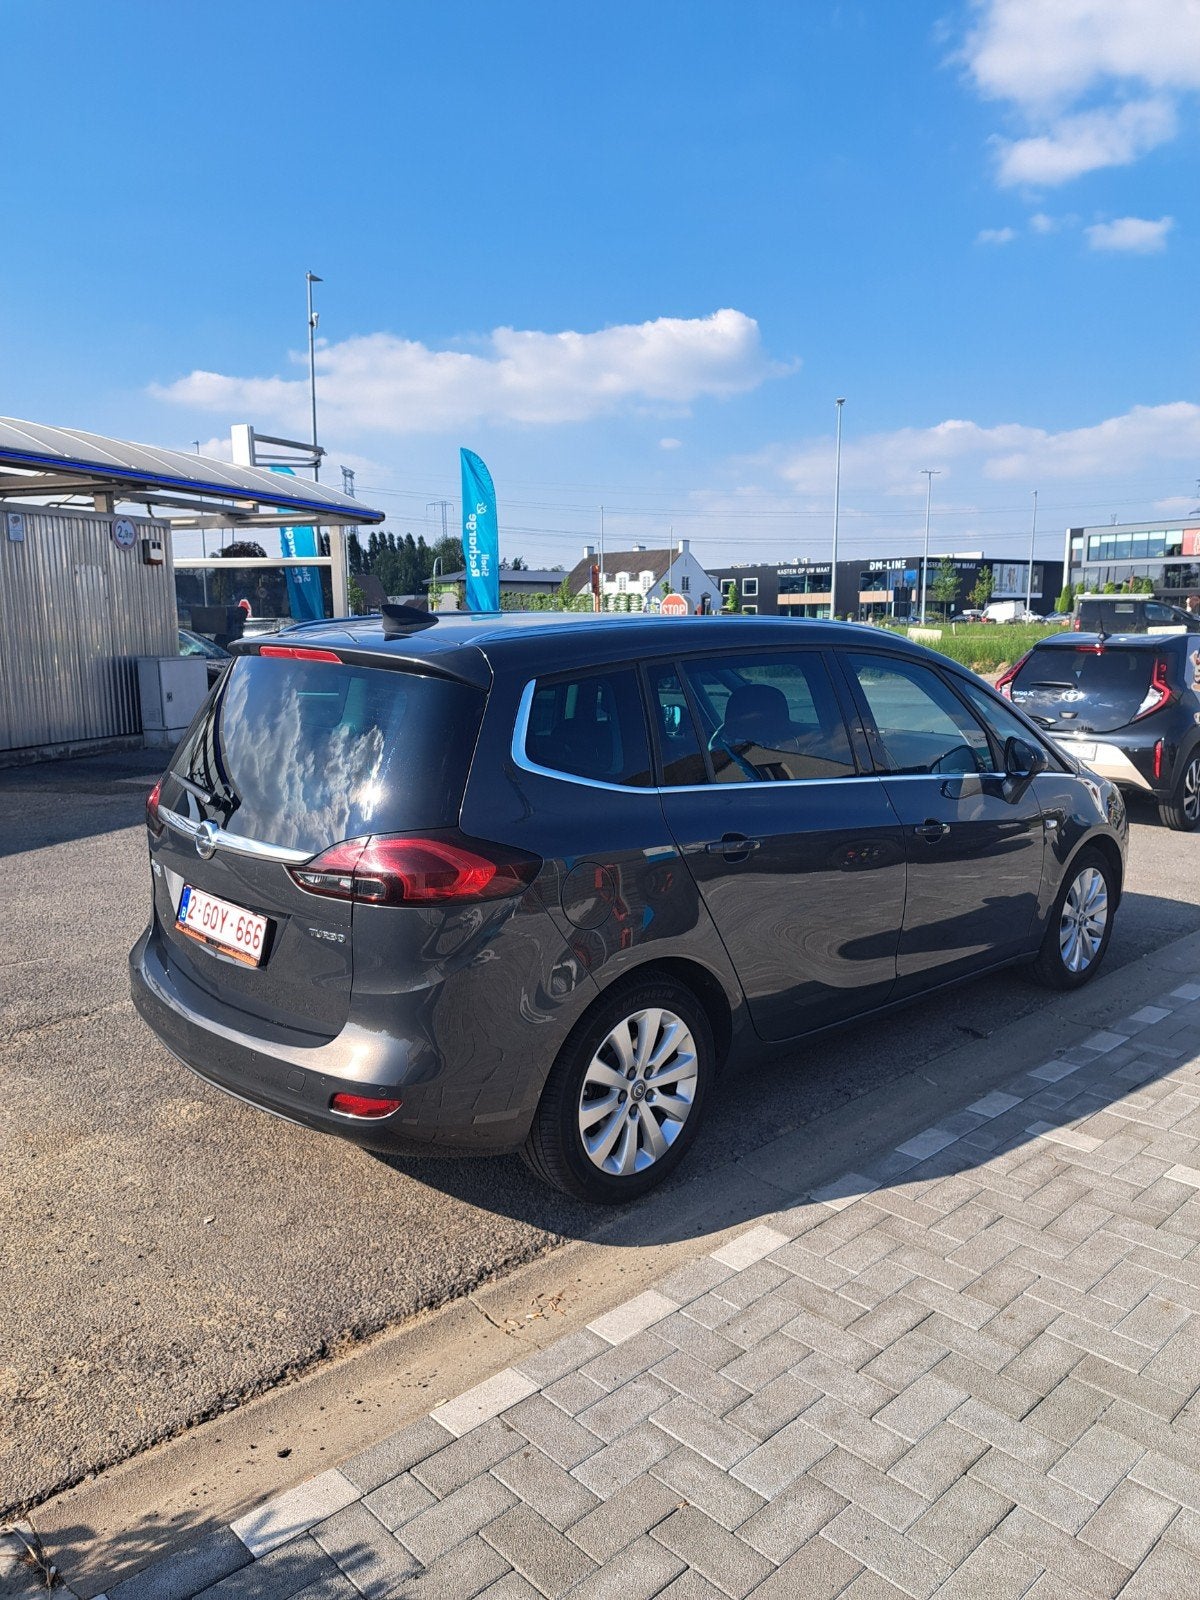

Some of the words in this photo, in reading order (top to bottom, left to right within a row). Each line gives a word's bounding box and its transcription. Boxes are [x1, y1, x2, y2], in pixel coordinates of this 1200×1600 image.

[869, 559, 907, 571] DM-LINE
[662, 604, 686, 615] STOP
[181, 907, 187, 918] B
[308, 927, 345, 943] TURBO
